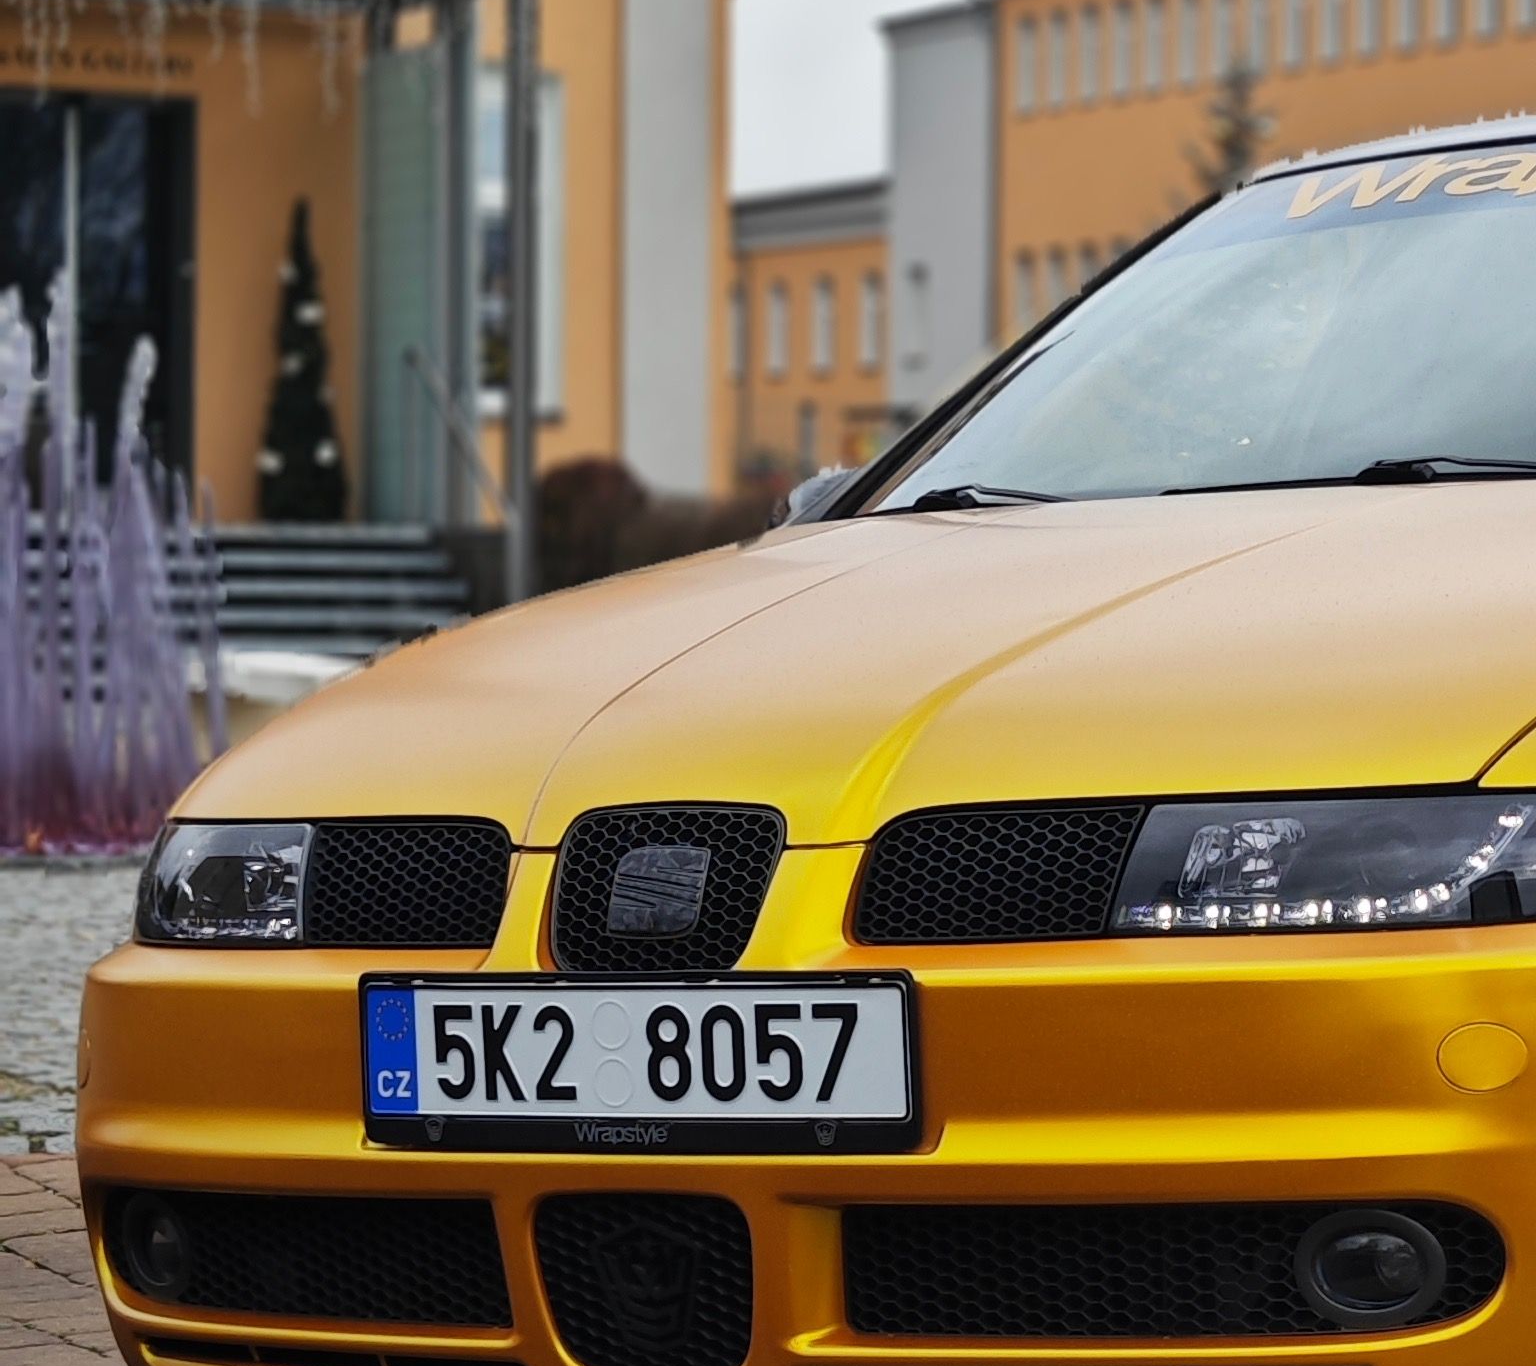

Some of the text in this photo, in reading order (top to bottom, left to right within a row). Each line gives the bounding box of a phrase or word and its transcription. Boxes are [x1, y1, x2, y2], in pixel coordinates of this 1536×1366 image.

[432, 1003, 859, 1102] 5K2 8057
[377, 1070, 412, 1098] CZ
[573, 1121, 668, 1146] Wrapstyle
